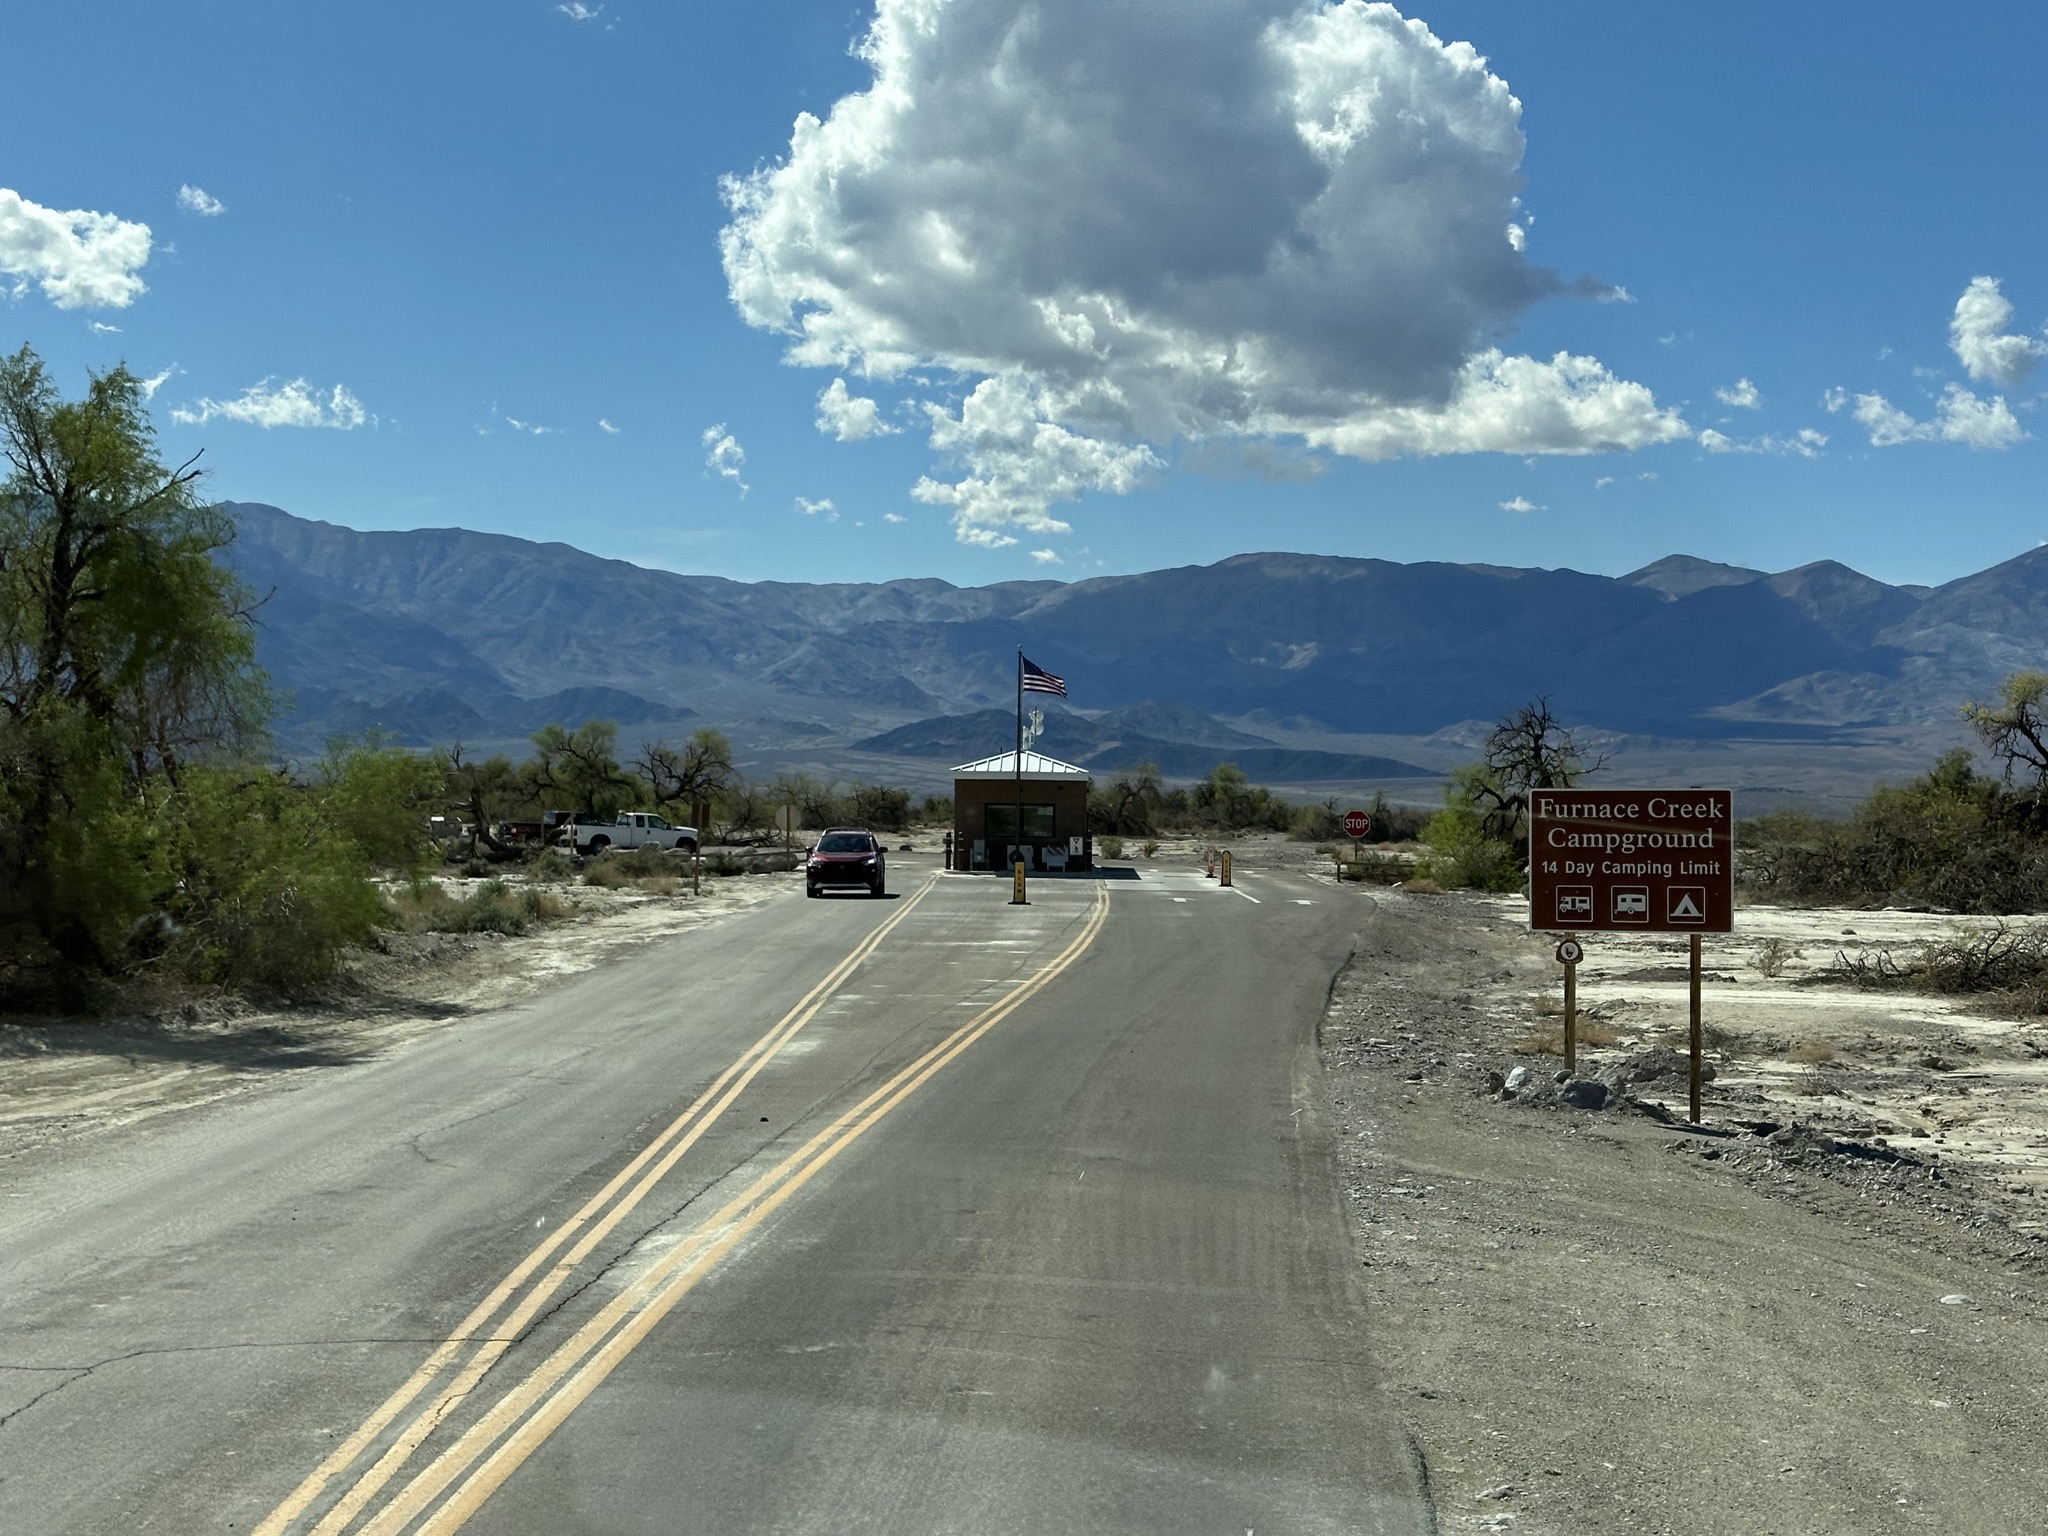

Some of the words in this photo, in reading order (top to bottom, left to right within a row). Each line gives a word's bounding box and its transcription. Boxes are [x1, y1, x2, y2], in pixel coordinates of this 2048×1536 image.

[1538, 798, 1639, 818] Furnace
[1647, 797, 1724, 818] Creek
[1345, 819, 1368, 829] STOP
[1547, 827, 1714, 854] Campground
[1542, 861, 1558, 874] 14
[1565, 861, 1594, 877] Day
[1602, 860, 1672, 878] Camping
[1680, 860, 1721, 875] Limit
